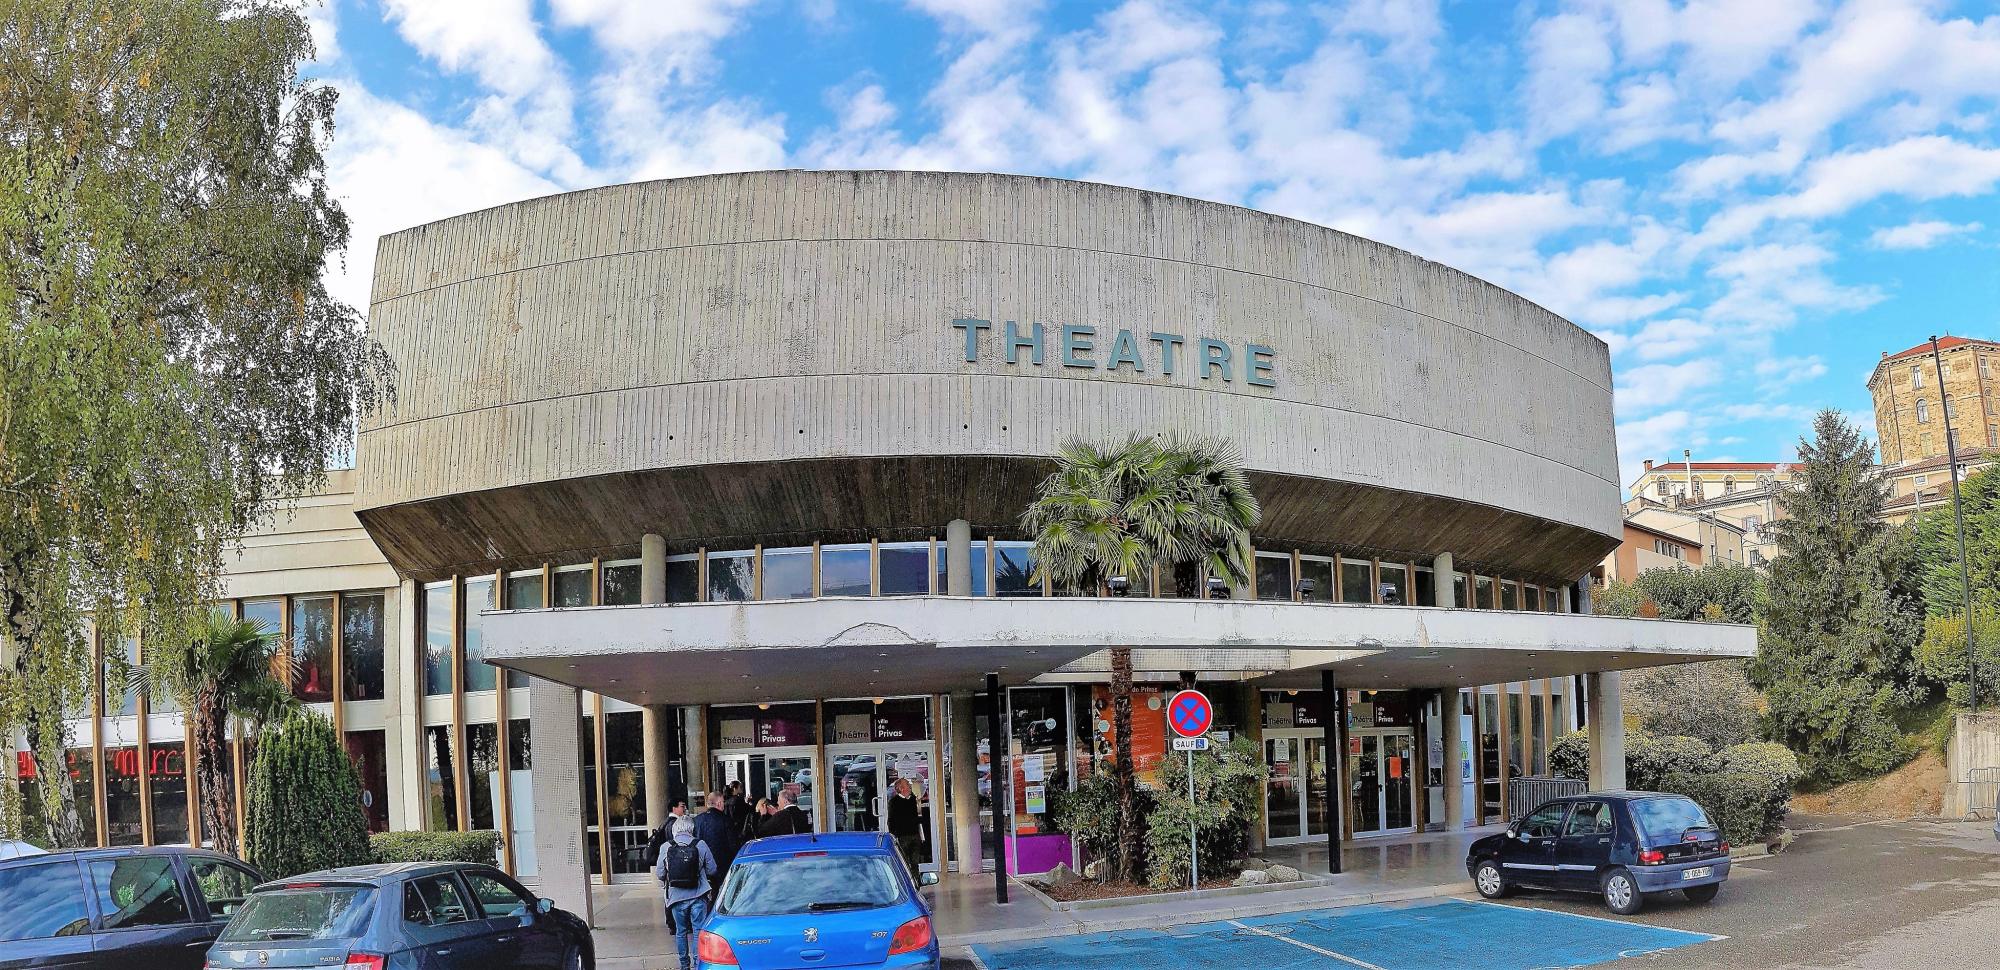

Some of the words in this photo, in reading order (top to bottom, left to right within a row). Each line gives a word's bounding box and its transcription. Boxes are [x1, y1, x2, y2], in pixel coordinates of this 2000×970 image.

[952, 318, 1277, 388] THEATRE
[838, 730, 870, 739] Théâtre
[878, 729, 903, 738] Privas
[722, 735, 753, 745] Théâtre
[761, 734, 786, 743] Privas
[1175, 740, 1195, 748] SAUF
